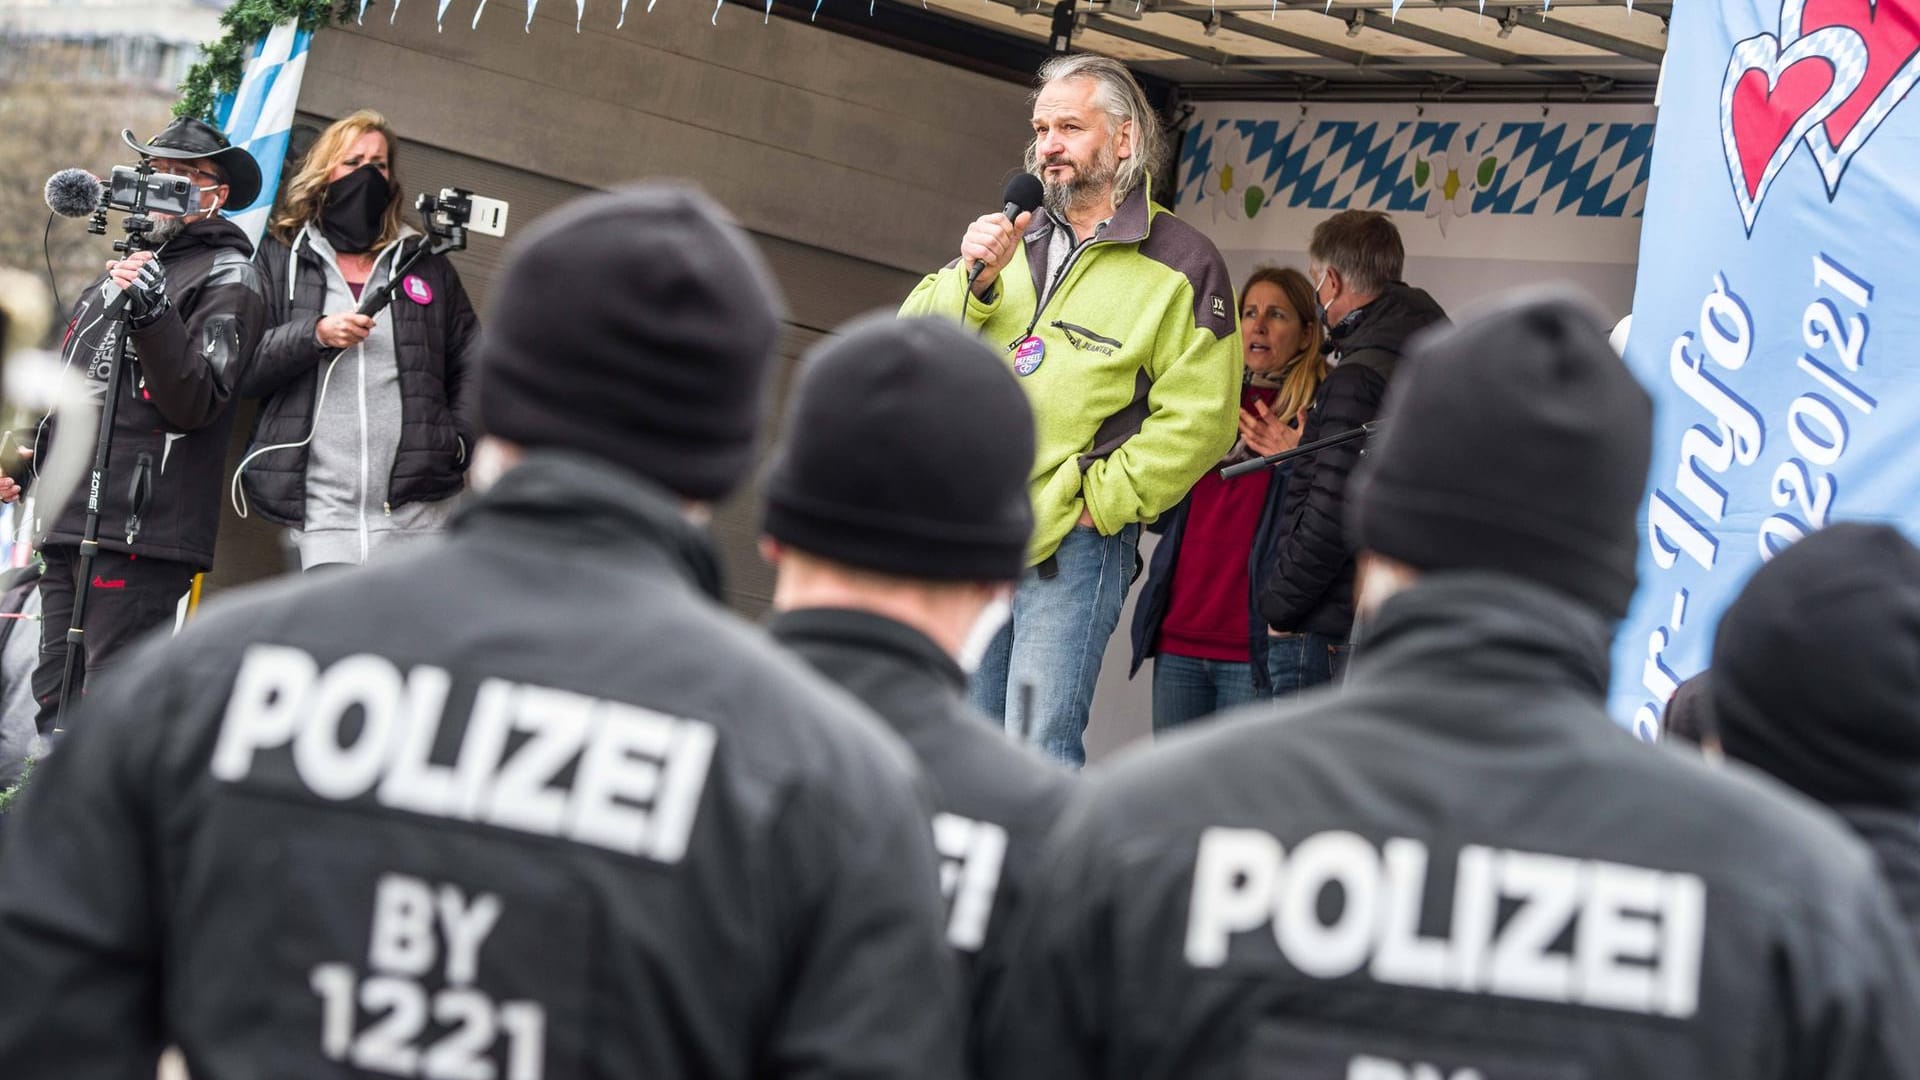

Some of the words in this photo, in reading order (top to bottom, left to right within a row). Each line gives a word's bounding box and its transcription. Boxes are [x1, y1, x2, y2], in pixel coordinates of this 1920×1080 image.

[1758, 252, 1878, 562] 020/21
[213, 644, 716, 864] POLIZEI
[370, 874, 501, 985] BY
[1185, 826, 1706, 1017] POLIZEI
[311, 963, 544, 1080] 1221
